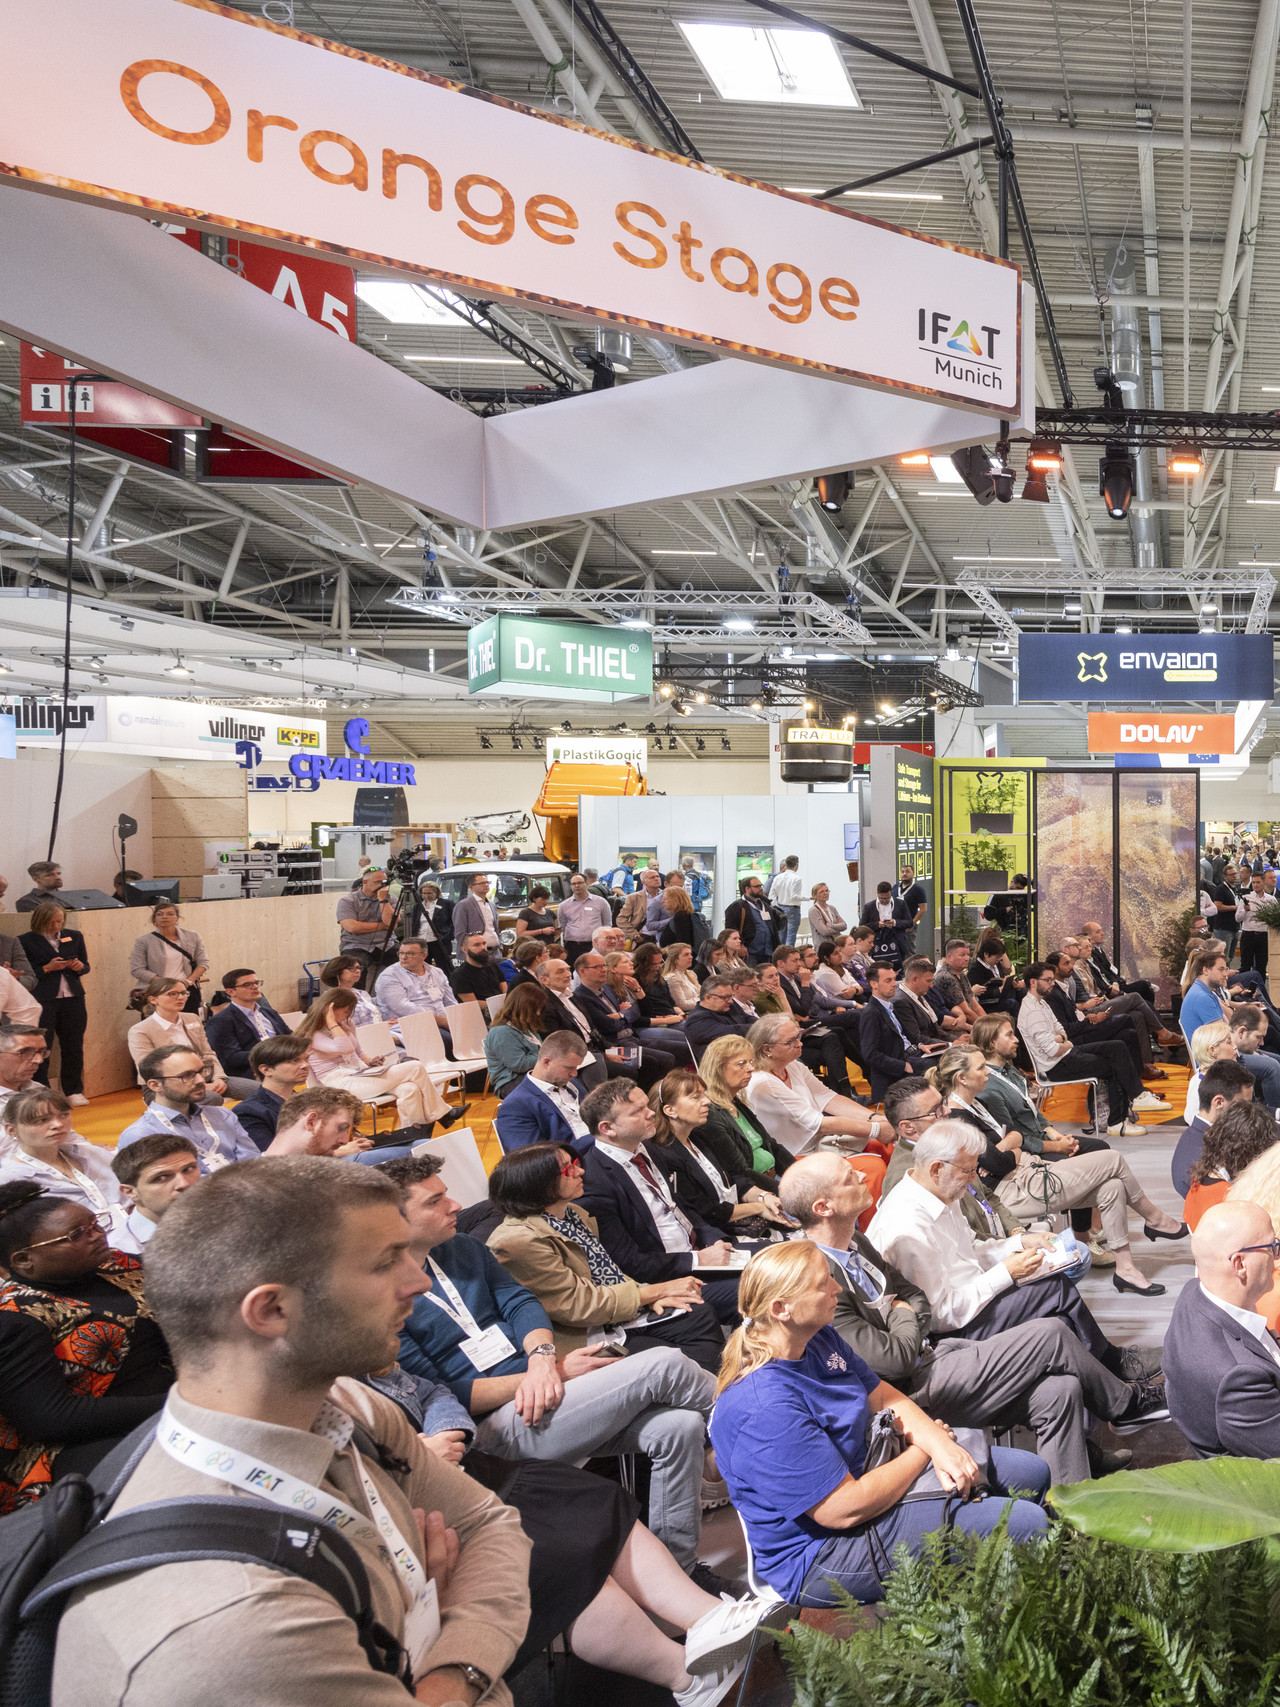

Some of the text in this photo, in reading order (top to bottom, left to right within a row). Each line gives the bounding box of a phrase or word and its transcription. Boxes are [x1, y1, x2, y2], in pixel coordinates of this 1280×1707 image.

[119, 58, 861, 324] Orange Stage
[917, 308, 1001, 359] IFAT
[935, 356, 1003, 390] Munich
[514, 636, 551, 672] Dr.
[1119, 652, 1218, 669] envaion
[791, 730, 852, 743] TRAFLUX
[289, 753, 417, 786] CRAEMER
[244, 1466, 284, 1492] IFAT
[323, 1506, 356, 1529] IFAT
